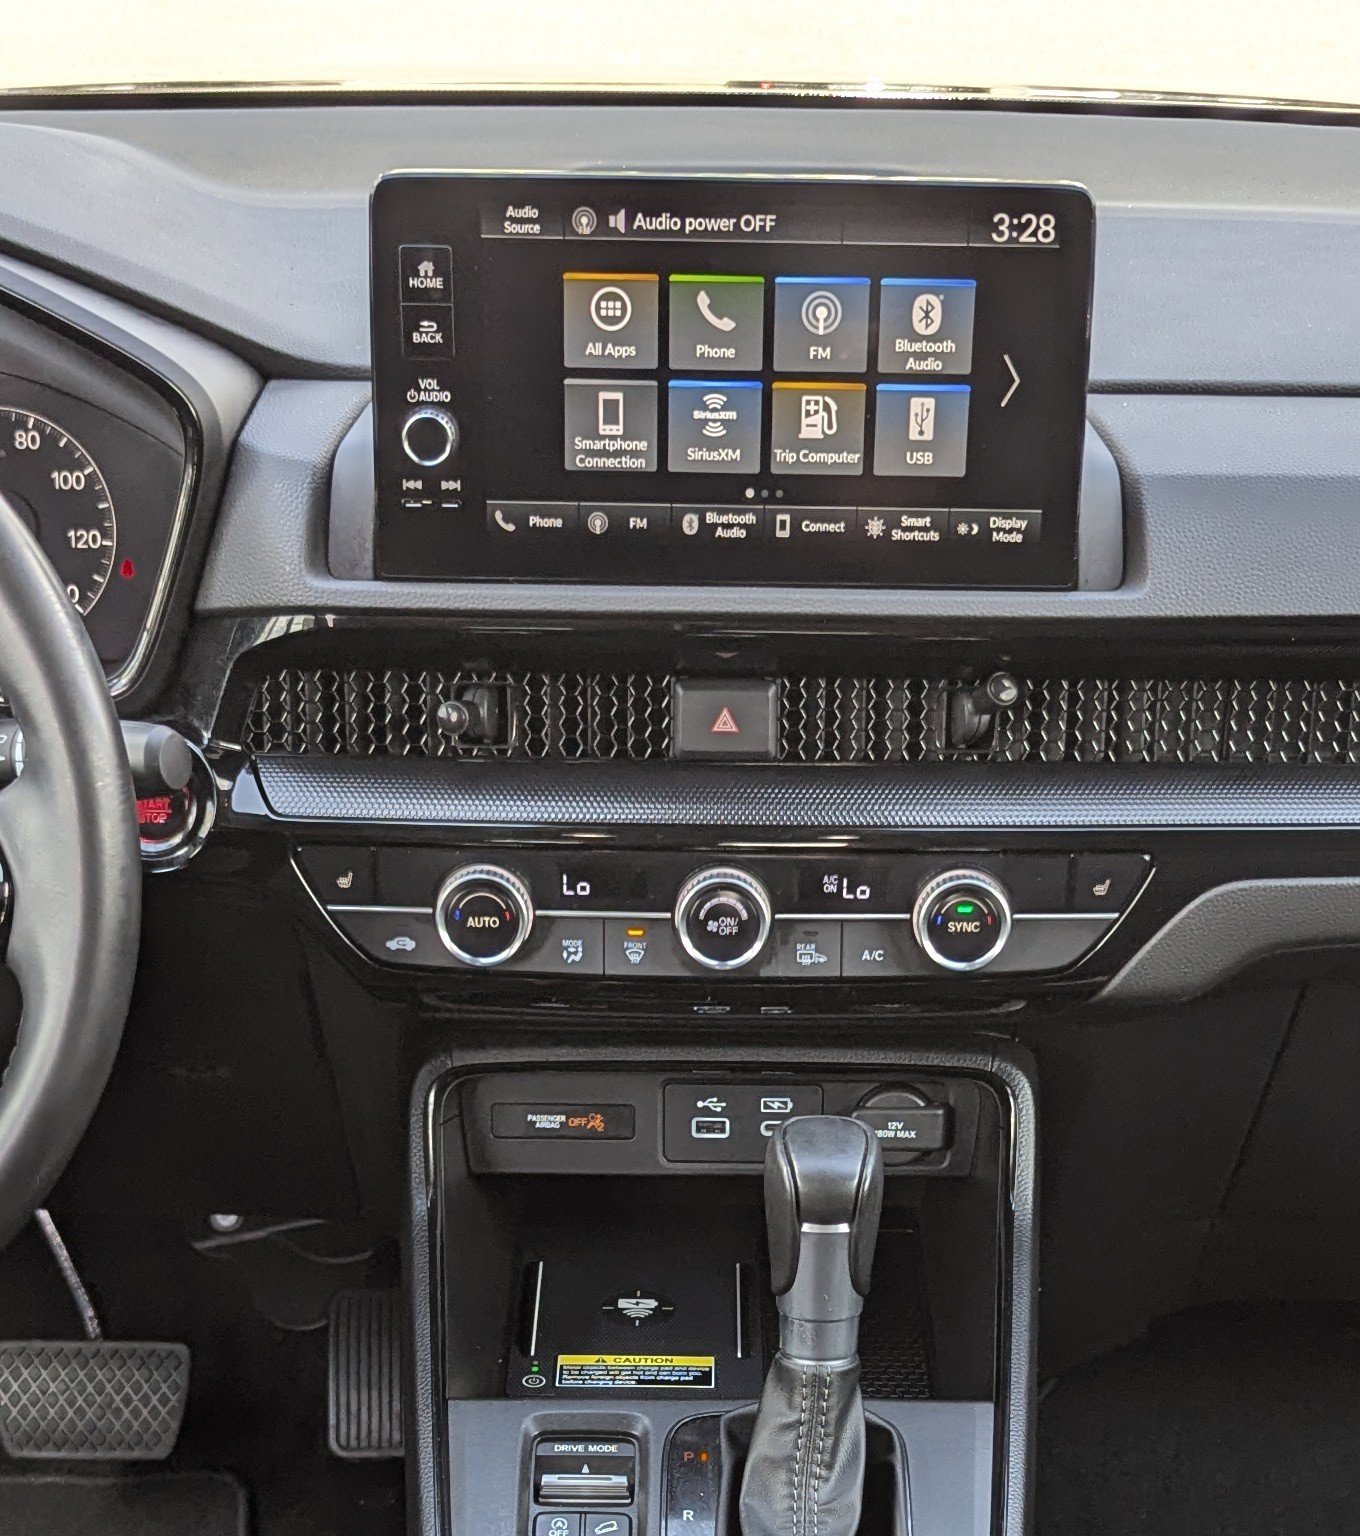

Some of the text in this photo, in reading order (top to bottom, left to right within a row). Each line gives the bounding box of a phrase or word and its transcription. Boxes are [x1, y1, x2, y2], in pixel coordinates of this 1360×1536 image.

[506, 205, 539, 219] Audio
[504, 221, 540, 234] Source
[633, 213, 776, 234] Audio power OFF
[991, 212, 1056, 243] 3:28
[409, 276, 443, 289] HOME
[412, 332, 443, 344] BACK
[585, 343, 636, 359] All Apps
[696, 345, 736, 359] Phone
[895, 339, 955, 353] Bluetooth
[809, 347, 831, 360] FM
[905, 357, 942, 371] Audio
[418, 378, 440, 390] VOL
[419, 390, 451, 402] AUDIO
[14, 430, 40, 450] 80
[574, 437, 648, 453] Smartphone
[687, 447, 740, 462] SiriusXM
[774, 449, 860, 465] Trip Computer
[906, 452, 933, 465] USB
[575, 454, 646, 469] Connection
[51, 471, 85, 490] 100
[529, 516, 562, 528] Phone
[629, 518, 648, 529] FM
[705, 512, 756, 524] Bluetooth
[900, 516, 931, 527] Smart
[990, 517, 1028, 530] Display
[715, 527, 746, 538] Audio
[801, 521, 845, 532] Connect
[67, 529, 101, 549] 120
[891, 530, 940, 542] Shortcuts
[992, 531, 1023, 543] Mode
[562, 874, 590, 896] Lo
[823, 875, 838, 885] A/C
[823, 884, 838, 893] ON
[842, 878, 871, 900] Lo
[466, 917, 499, 928] AUTO
[719, 917, 738, 927] ON/
[947, 921, 980, 933] SYNC
[719, 926, 739, 936] OFF
[562, 939, 583, 947] MODE
[623, 941, 647, 949] FRONT
[862, 950, 884, 961] A/C
[527, 1114, 566, 1122] PASSENGER
[568, 1117, 588, 1127] OFF
[535, 1121, 560, 1129] AIRBAG
[887, 1121, 904, 1130] 12V
[896, 1130, 916, 1138] MAX
[554, 1444, 618, 1452] DRIVE MODE
[683, 1451, 694, 1462] P
[682, 1509, 694, 1521] R
